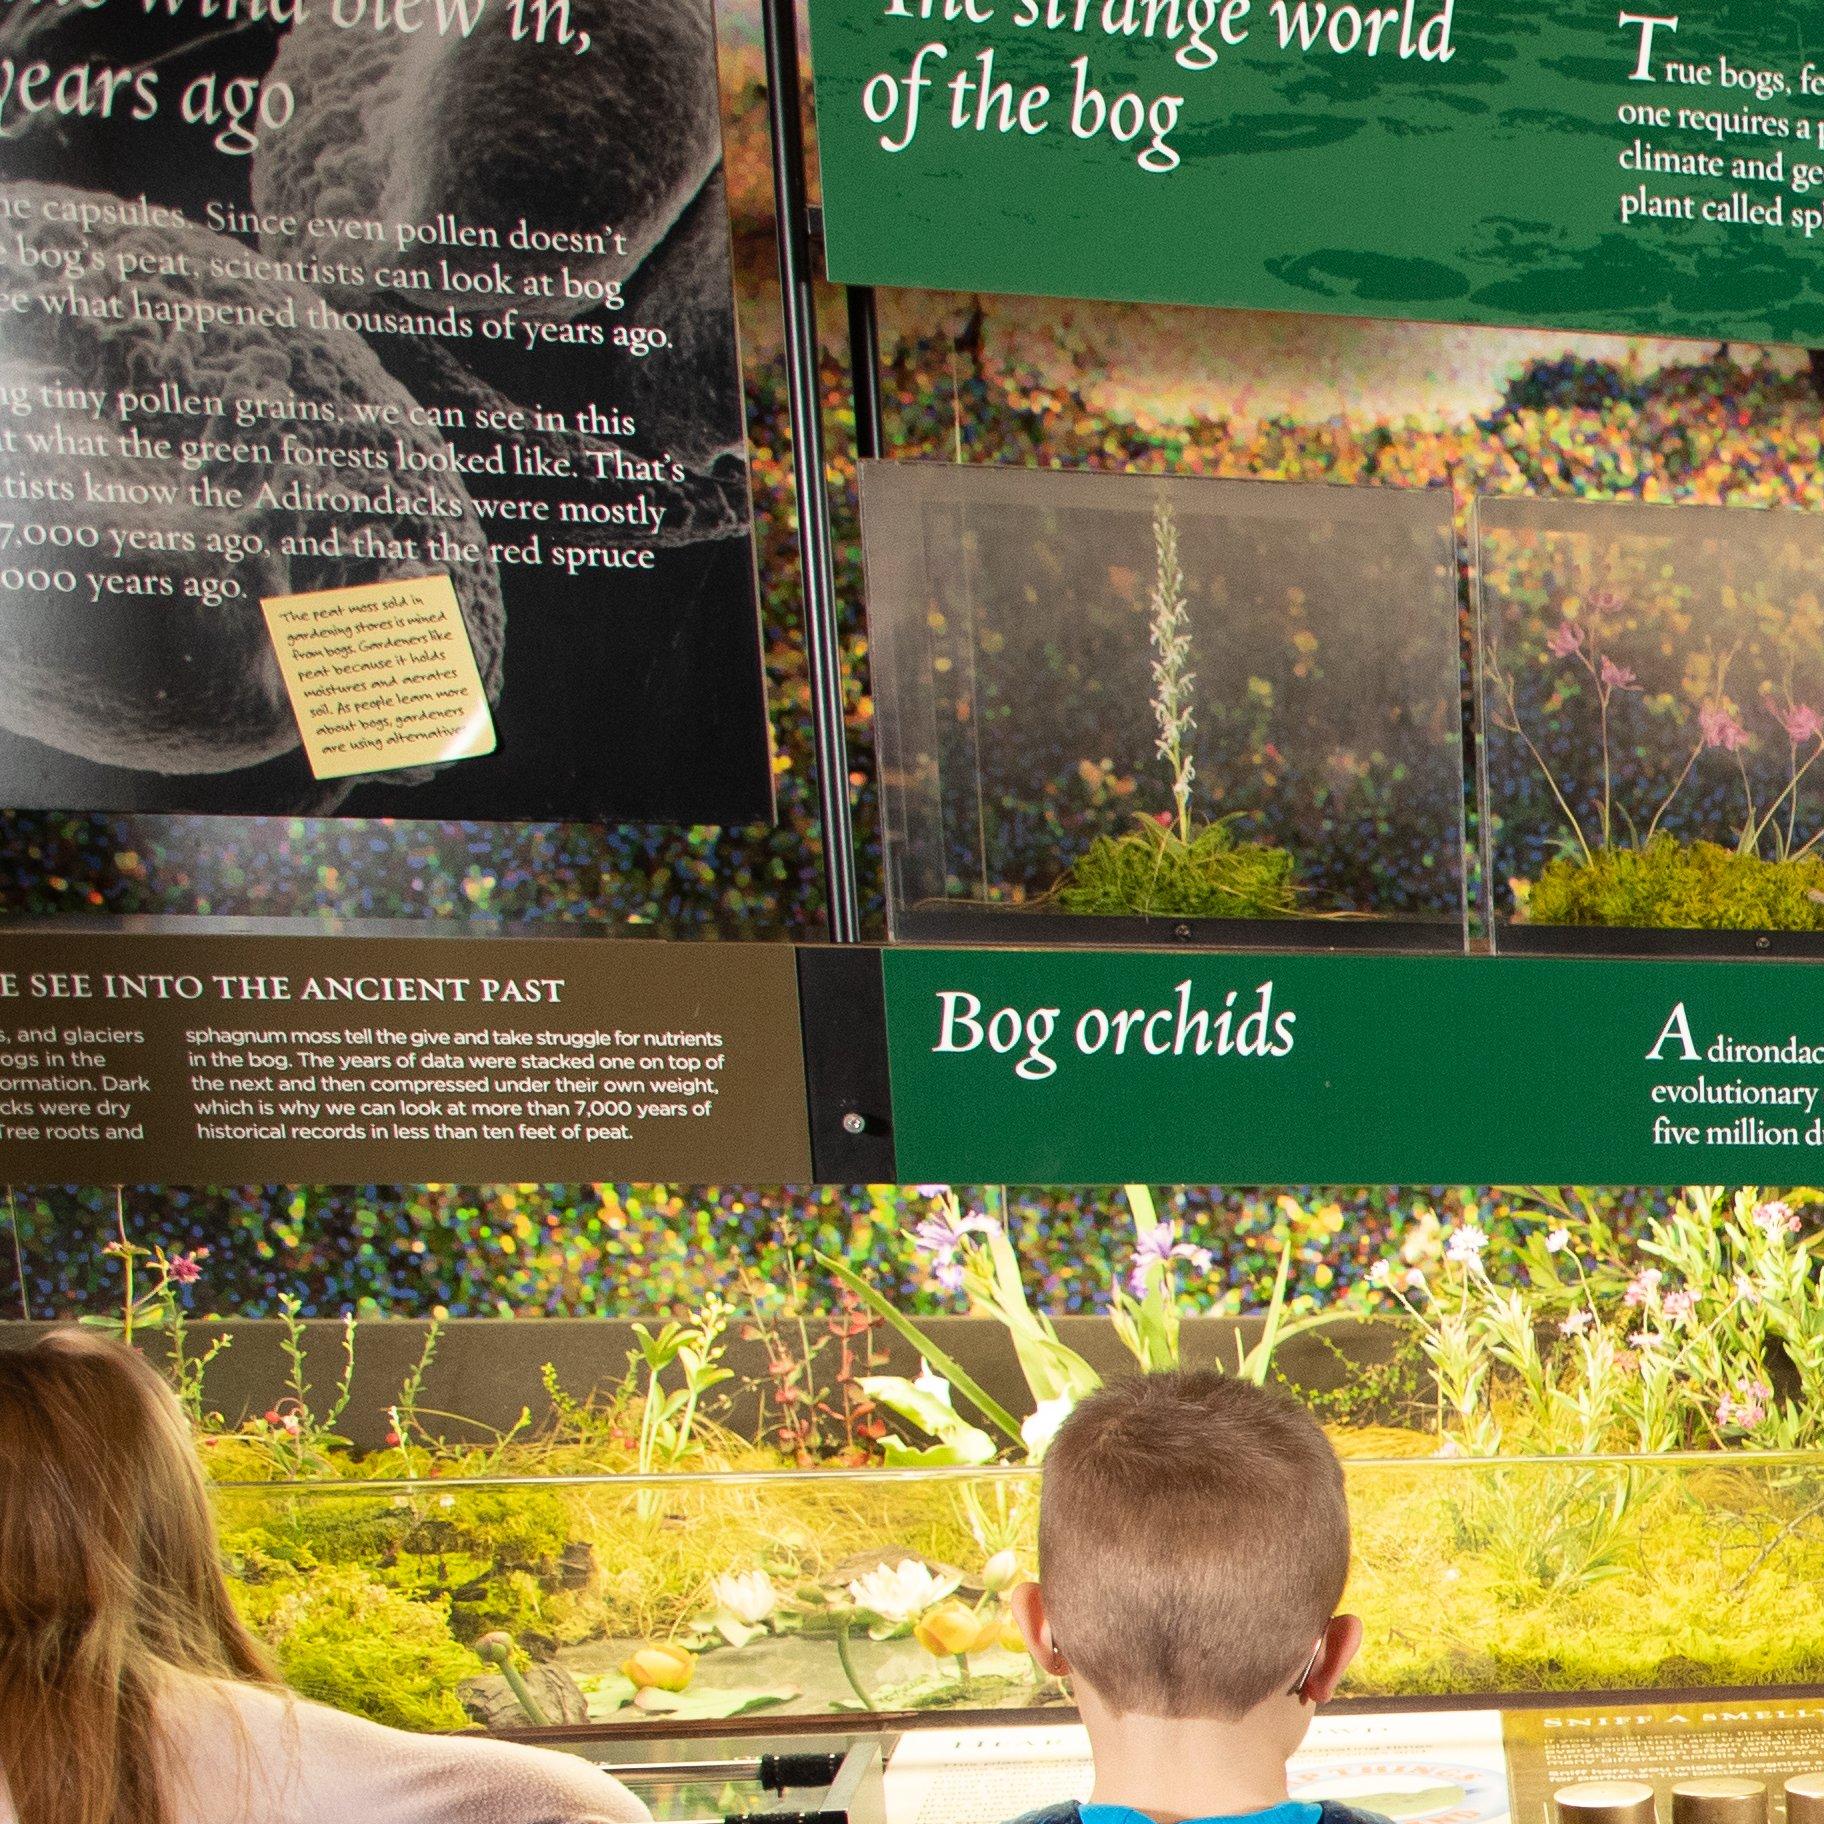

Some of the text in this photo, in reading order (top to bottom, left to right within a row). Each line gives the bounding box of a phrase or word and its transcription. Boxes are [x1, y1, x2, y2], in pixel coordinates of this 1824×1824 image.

[1270, 0, 1457, 63] world
[1617, 11, 1713, 88] True
[1719, 56, 1792, 98] bogs,
[182, 73, 294, 155] ago
[862, 43, 1185, 172] of the bog
[42, 193, 628, 256] capsules. Since even pollen doesn't
[19, 234, 626, 311] bog's peat, scientists can look at bog
[280, 595, 424, 623] The peat moss sold in
[287, 612, 448, 645] gardening stores is mined
[30, 973, 93, 998] SEE
[104, 974, 203, 999] INTO
[212, 975, 292, 1000] THE
[300, 976, 470, 1002] ANCIENT
[480, 978, 565, 1003] PAST
[185, 1026, 724, 1049] sphagnum moss tell the give and take struggle for nutrients
[932, 979, 1297, 1081] Bog orchids
[196, 1122, 634, 1143] historical records in less than ten feet of peat.
[1543, 1716, 1653, 1728] SNIFF
[1666, 1713, 1690, 1724] A
